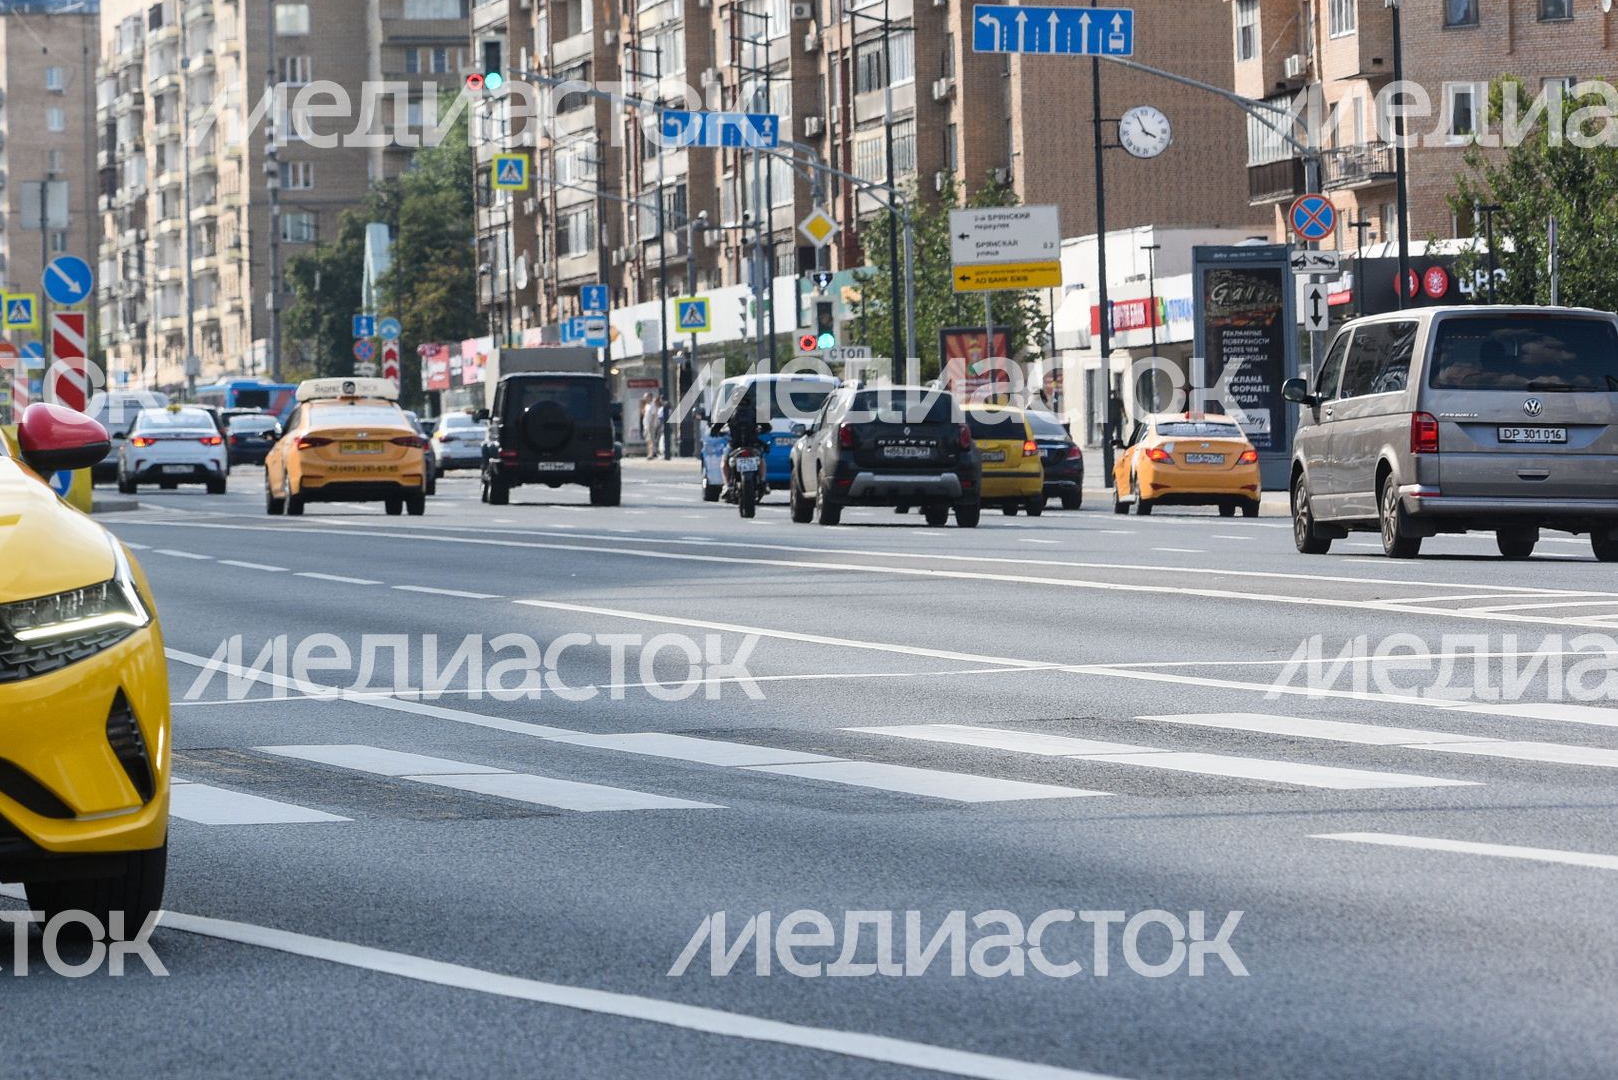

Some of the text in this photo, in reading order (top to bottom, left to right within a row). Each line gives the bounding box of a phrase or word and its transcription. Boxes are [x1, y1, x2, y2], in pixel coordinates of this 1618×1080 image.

[987, 212, 1030, 220] БРЯНСКИЙ
[975, 240, 1018, 248] БРЯНСКАЯ
[830, 348, 865, 359] СТОП
